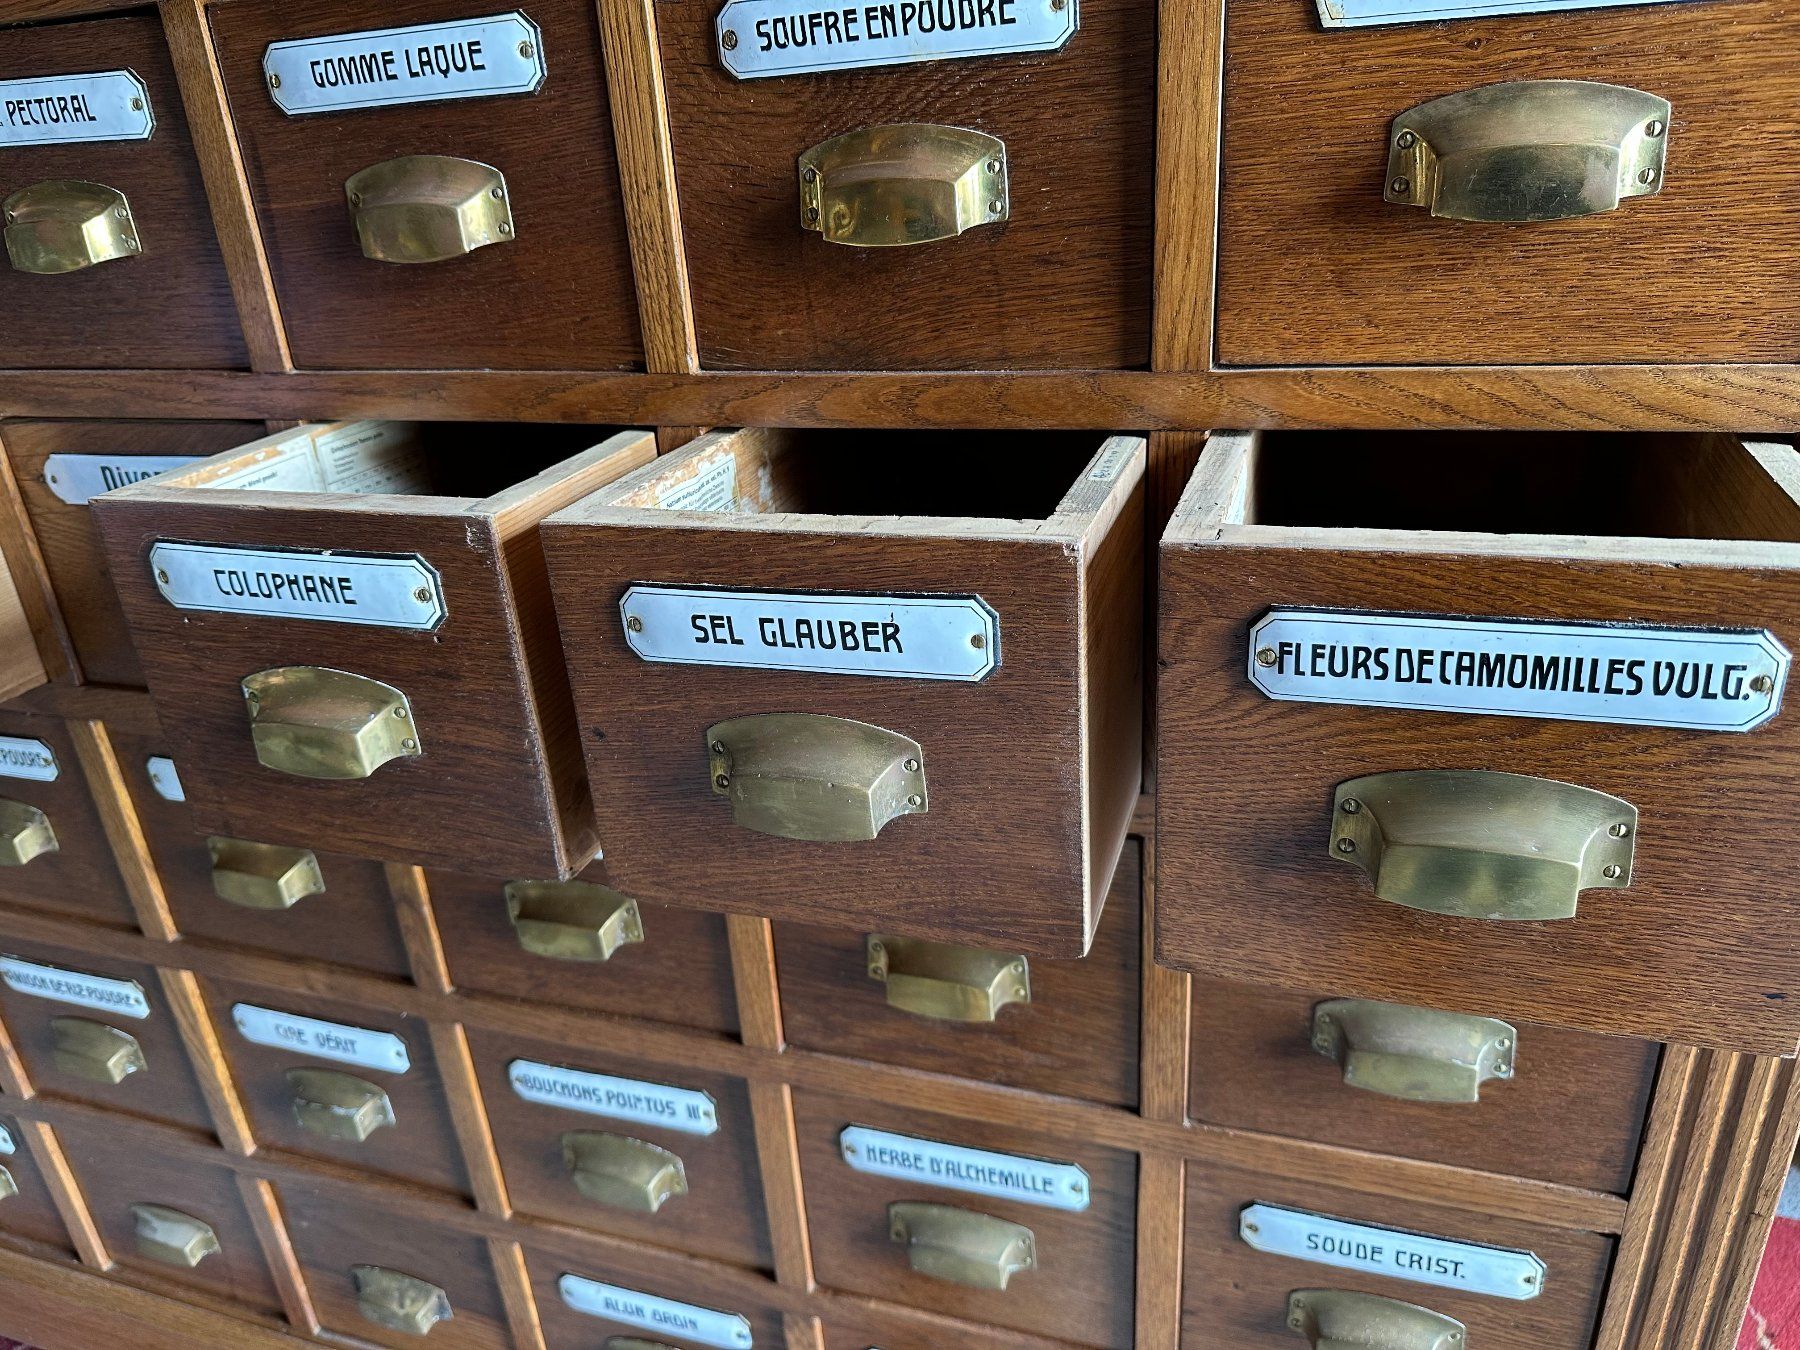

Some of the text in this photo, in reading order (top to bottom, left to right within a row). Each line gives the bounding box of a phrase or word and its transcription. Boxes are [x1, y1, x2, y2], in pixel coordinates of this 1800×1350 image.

[755, 0, 1017, 51] SOUFRE EN POUDRE
[309, 40, 486, 89] GOMME LAQUE
[5, 94, 97, 127] PECTORAL
[100, 465, 161, 491] Div
[213, 569, 358, 605] COLOPHANE
[690, 614, 904, 654] SEL GLAUBER
[1277, 641, 1750, 701] FLEURS DE CAMOMILLES VULG.
[523, 1073, 603, 1104] BOUCHONS
[866, 1145, 926, 1172] HERBE
[1305, 1233, 1466, 1280] SOUDE CRIST.
